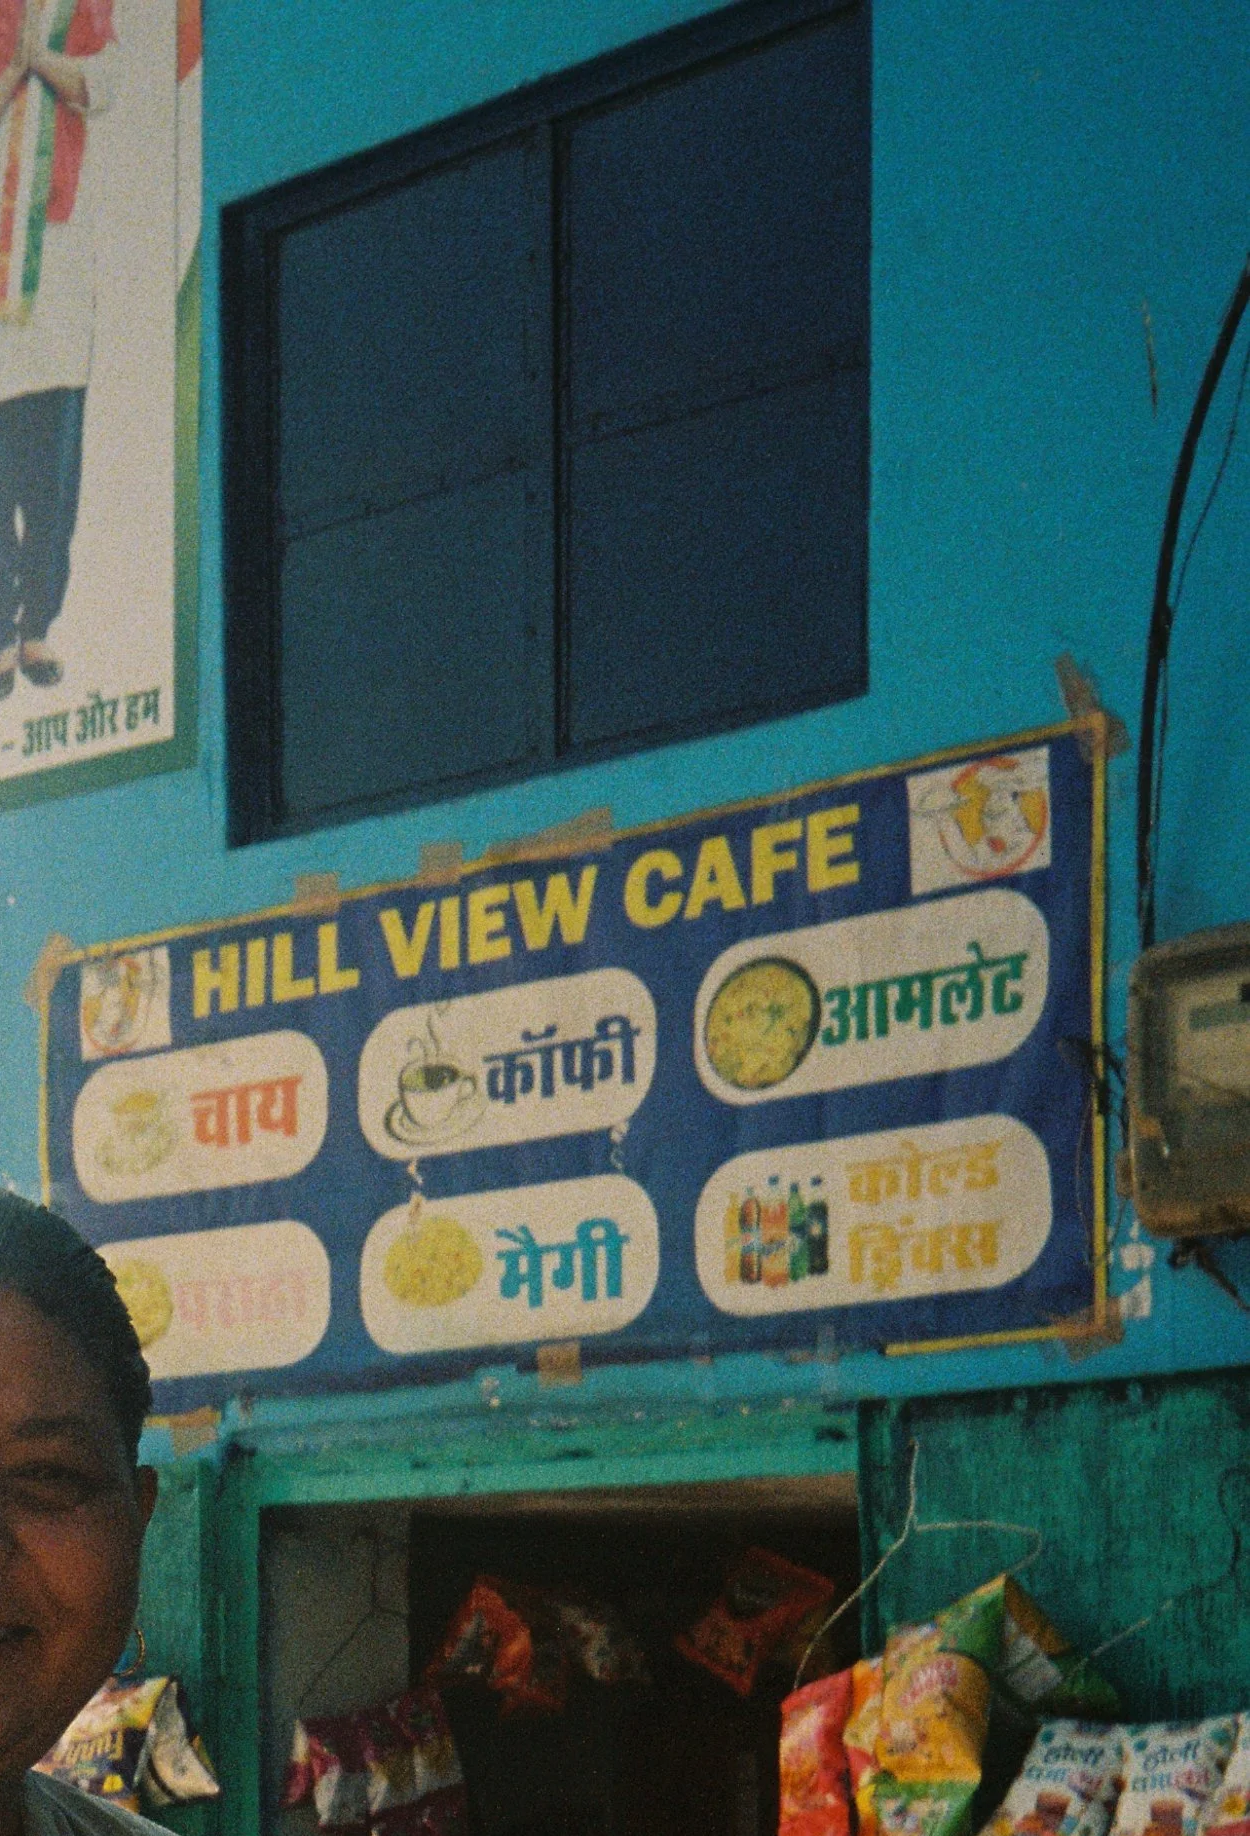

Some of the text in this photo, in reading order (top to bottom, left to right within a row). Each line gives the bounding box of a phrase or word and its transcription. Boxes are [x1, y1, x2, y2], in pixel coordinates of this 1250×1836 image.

[21, 711, 71, 756] आप
[75, 690, 119, 745] और
[124, 687, 161, 732] हम
[192, 803, 861, 1019] HILL VIEW CAFE
[821, 940, 1030, 1048] आमलेट
[483, 1014, 640, 1104] कॉफी
[191, 1074, 303, 1149] चाय
[846, 1139, 1003, 1206] कोल्ड
[494, 1217, 630, 1309] मैगी
